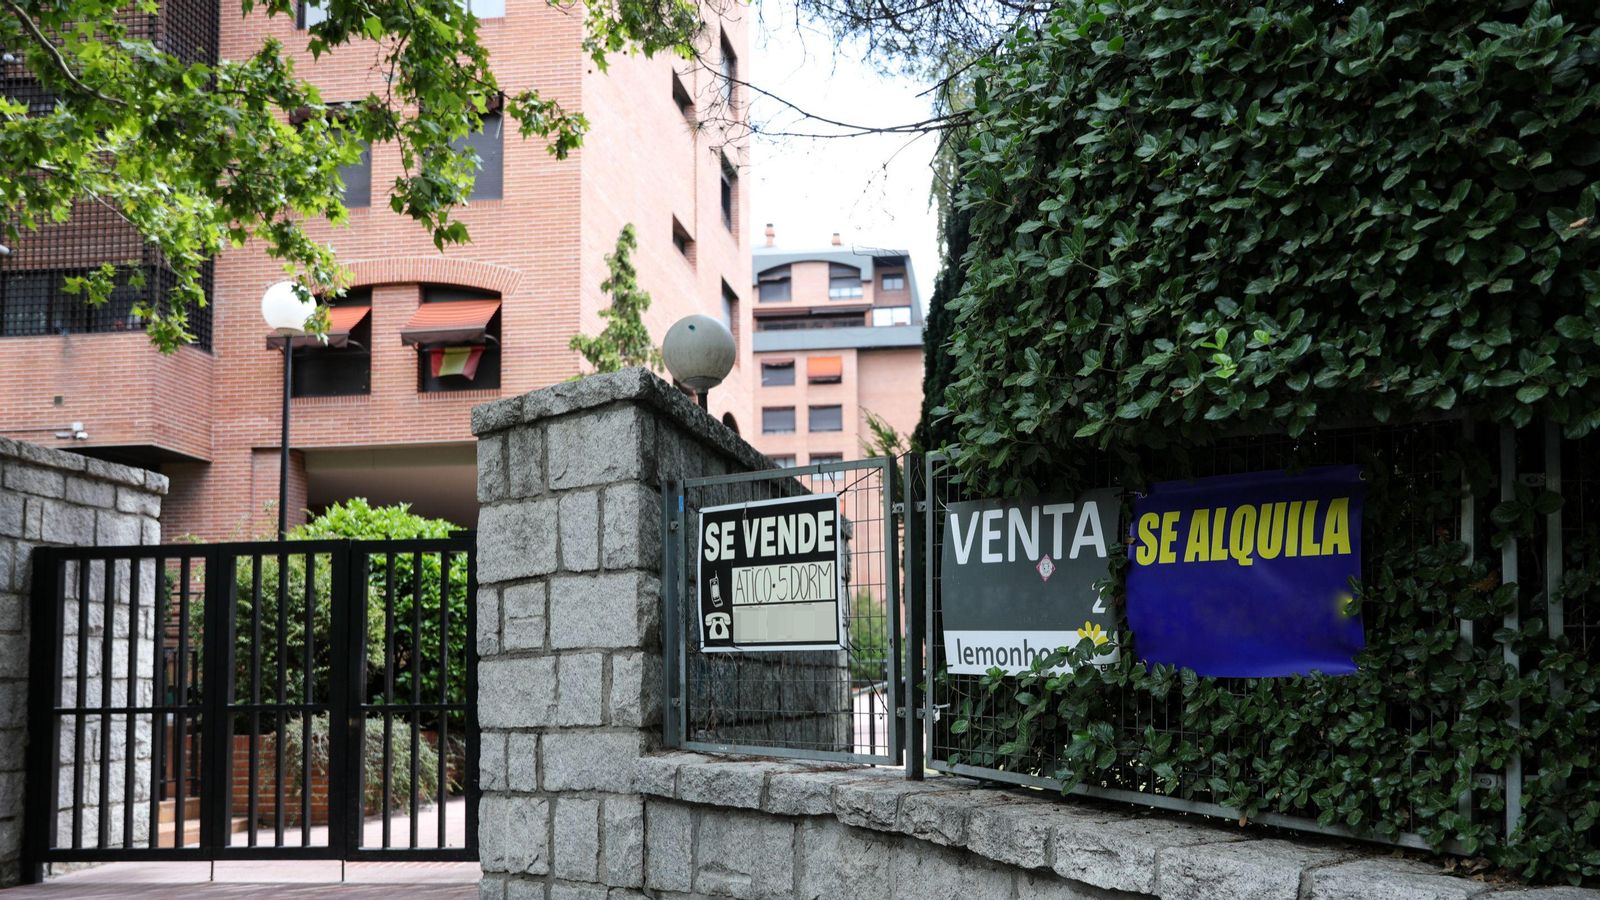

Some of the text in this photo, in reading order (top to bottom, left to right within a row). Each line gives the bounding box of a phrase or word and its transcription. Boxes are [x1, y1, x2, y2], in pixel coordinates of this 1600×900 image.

[704, 510, 835, 562] SE VENDE
[950, 501, 1107, 565] VENTA
[1135, 497, 1352, 566] SE ALQUILA
